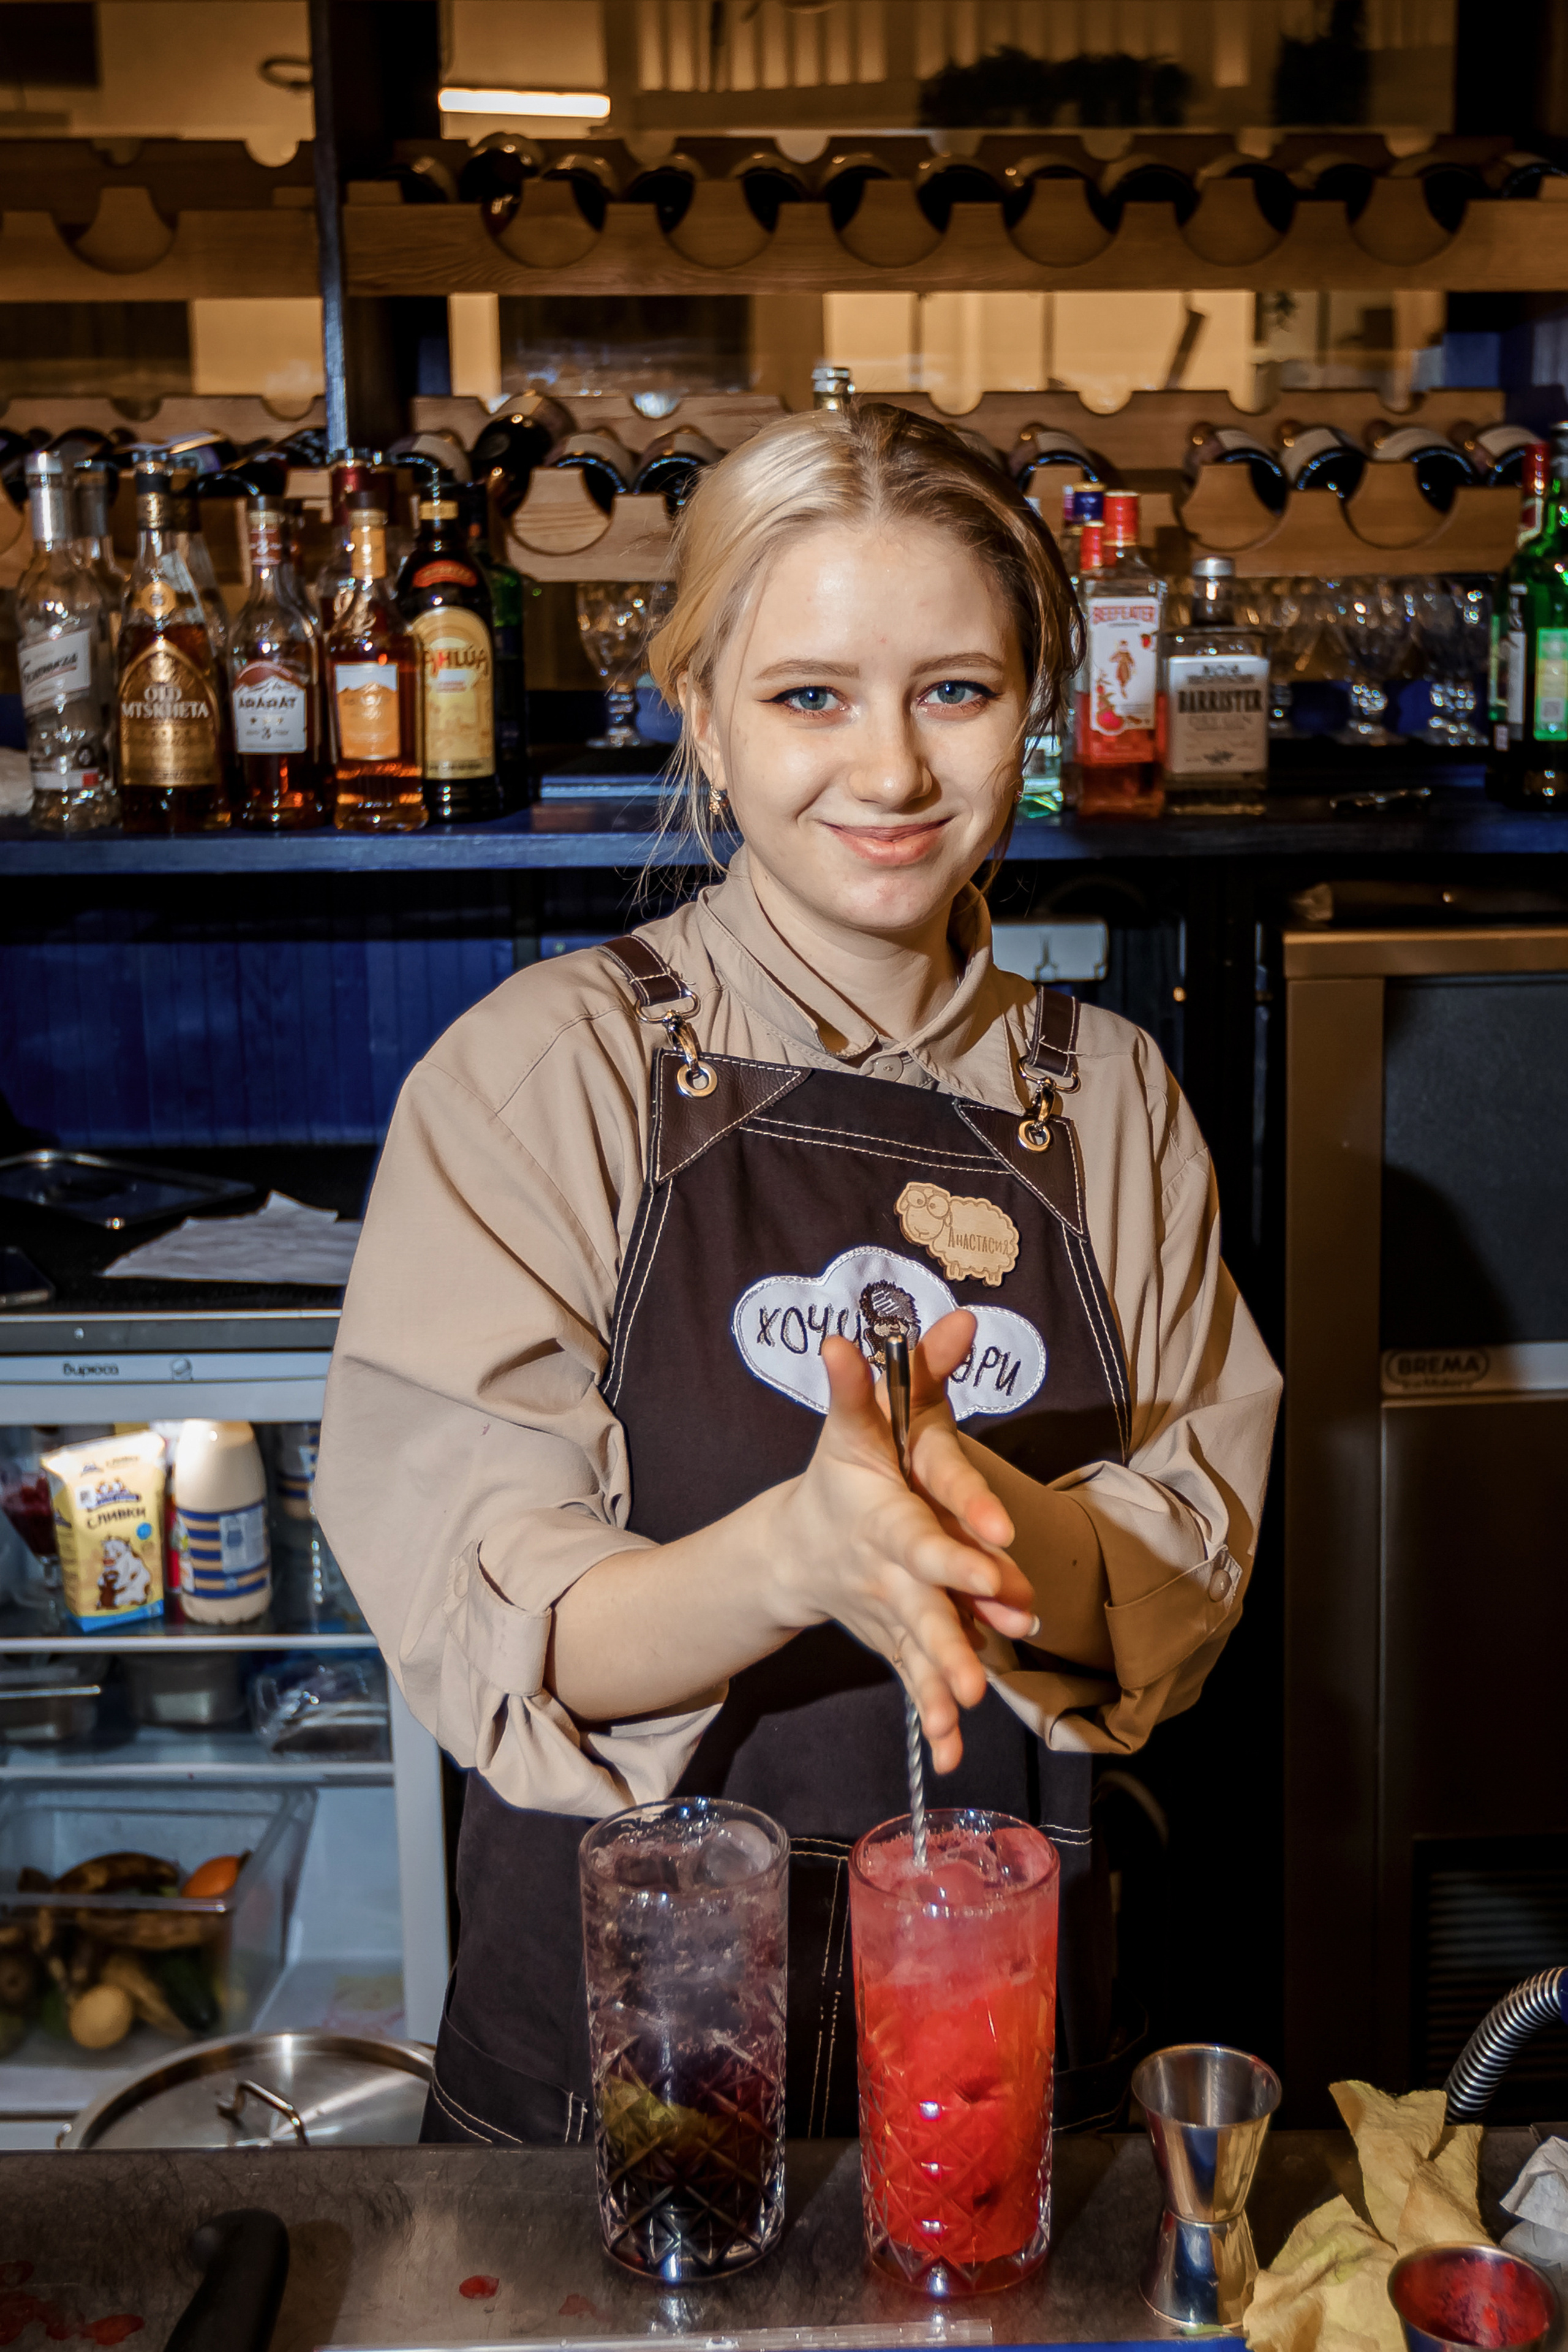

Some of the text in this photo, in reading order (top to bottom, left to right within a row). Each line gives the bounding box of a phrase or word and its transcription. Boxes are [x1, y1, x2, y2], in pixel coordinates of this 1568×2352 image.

[1093, 605, 1155, 624] BEEFEATER
[424, 645, 488, 677] AHLÚA
[143, 686, 183, 702] OLD
[238, 695, 298, 709] ARARAT
[1177, 690, 1263, 714] BARRISTER
[121, 701, 210, 718] MTSKHETA
[1398, 1355, 1480, 1375] BREMA
[86, 1506, 146, 1530] СЛИВКИ
